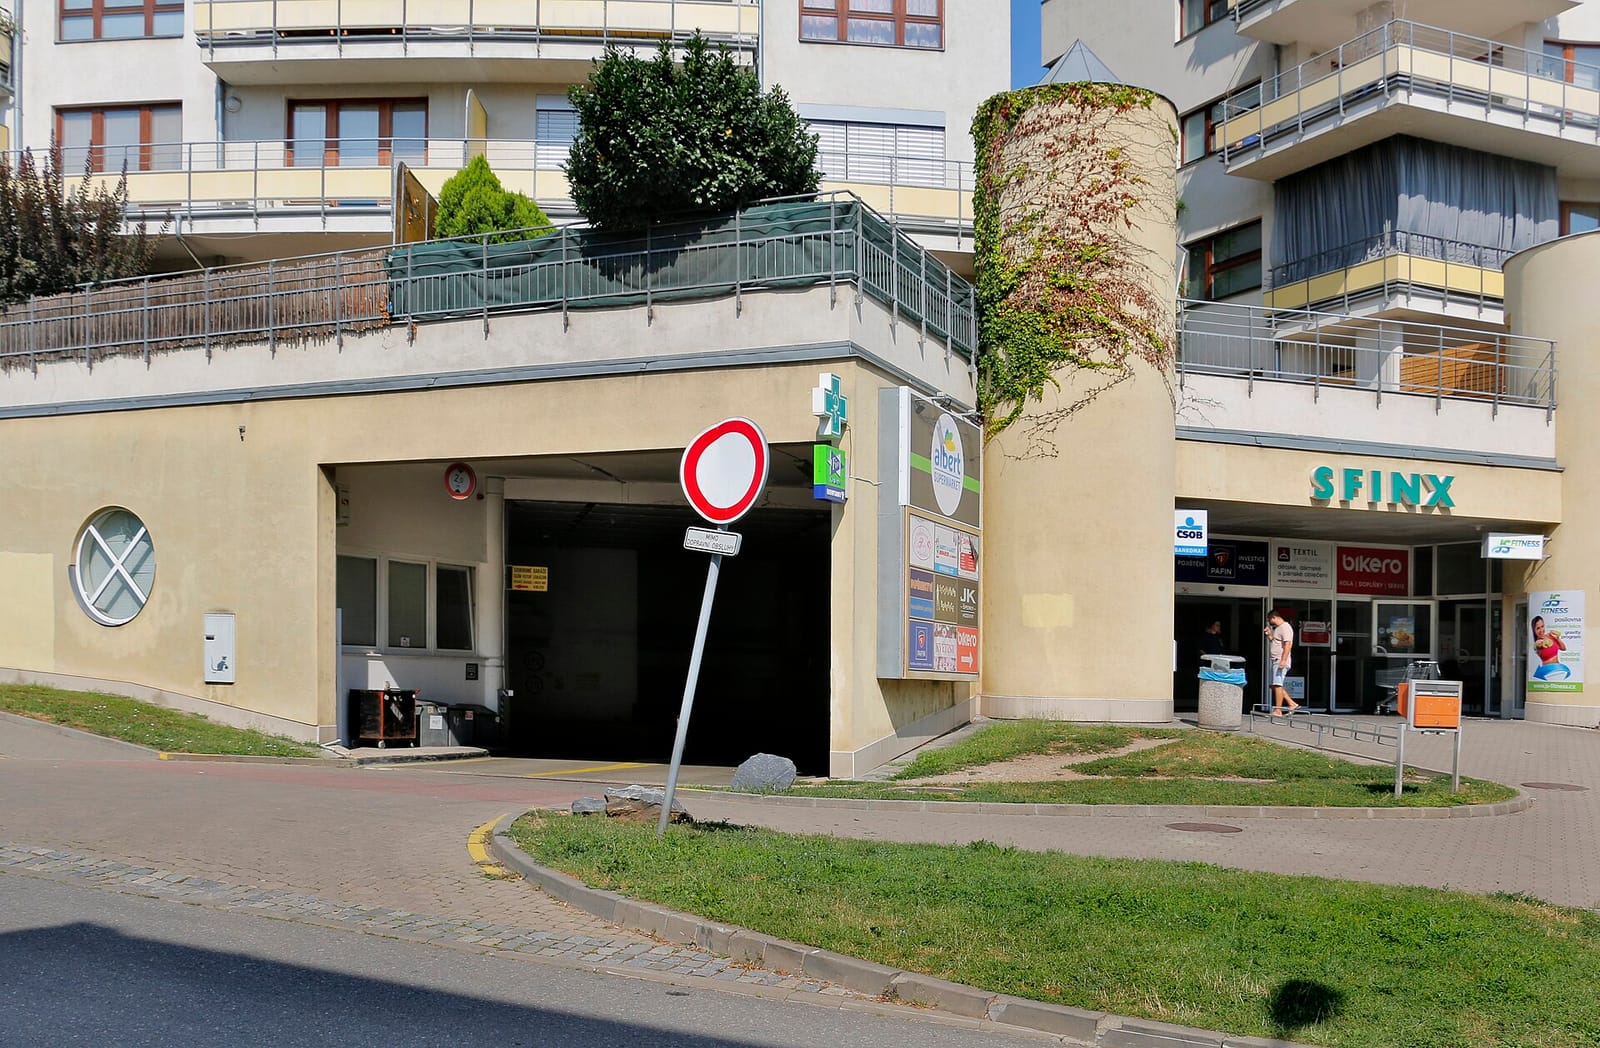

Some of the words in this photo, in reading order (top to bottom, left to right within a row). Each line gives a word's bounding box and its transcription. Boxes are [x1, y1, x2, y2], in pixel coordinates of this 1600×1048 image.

[934, 445, 961, 475] albert
[934, 471, 961, 491] SUPERMARKET
[1310, 466, 1456, 507] SFINX
[1293, 548, 1319, 557] TEXTIL
[1511, 540, 1540, 548] FITNESS
[1342, 554, 1402, 575] bikero
[960, 587, 976, 604] JK
[957, 631, 977, 647] bikero
